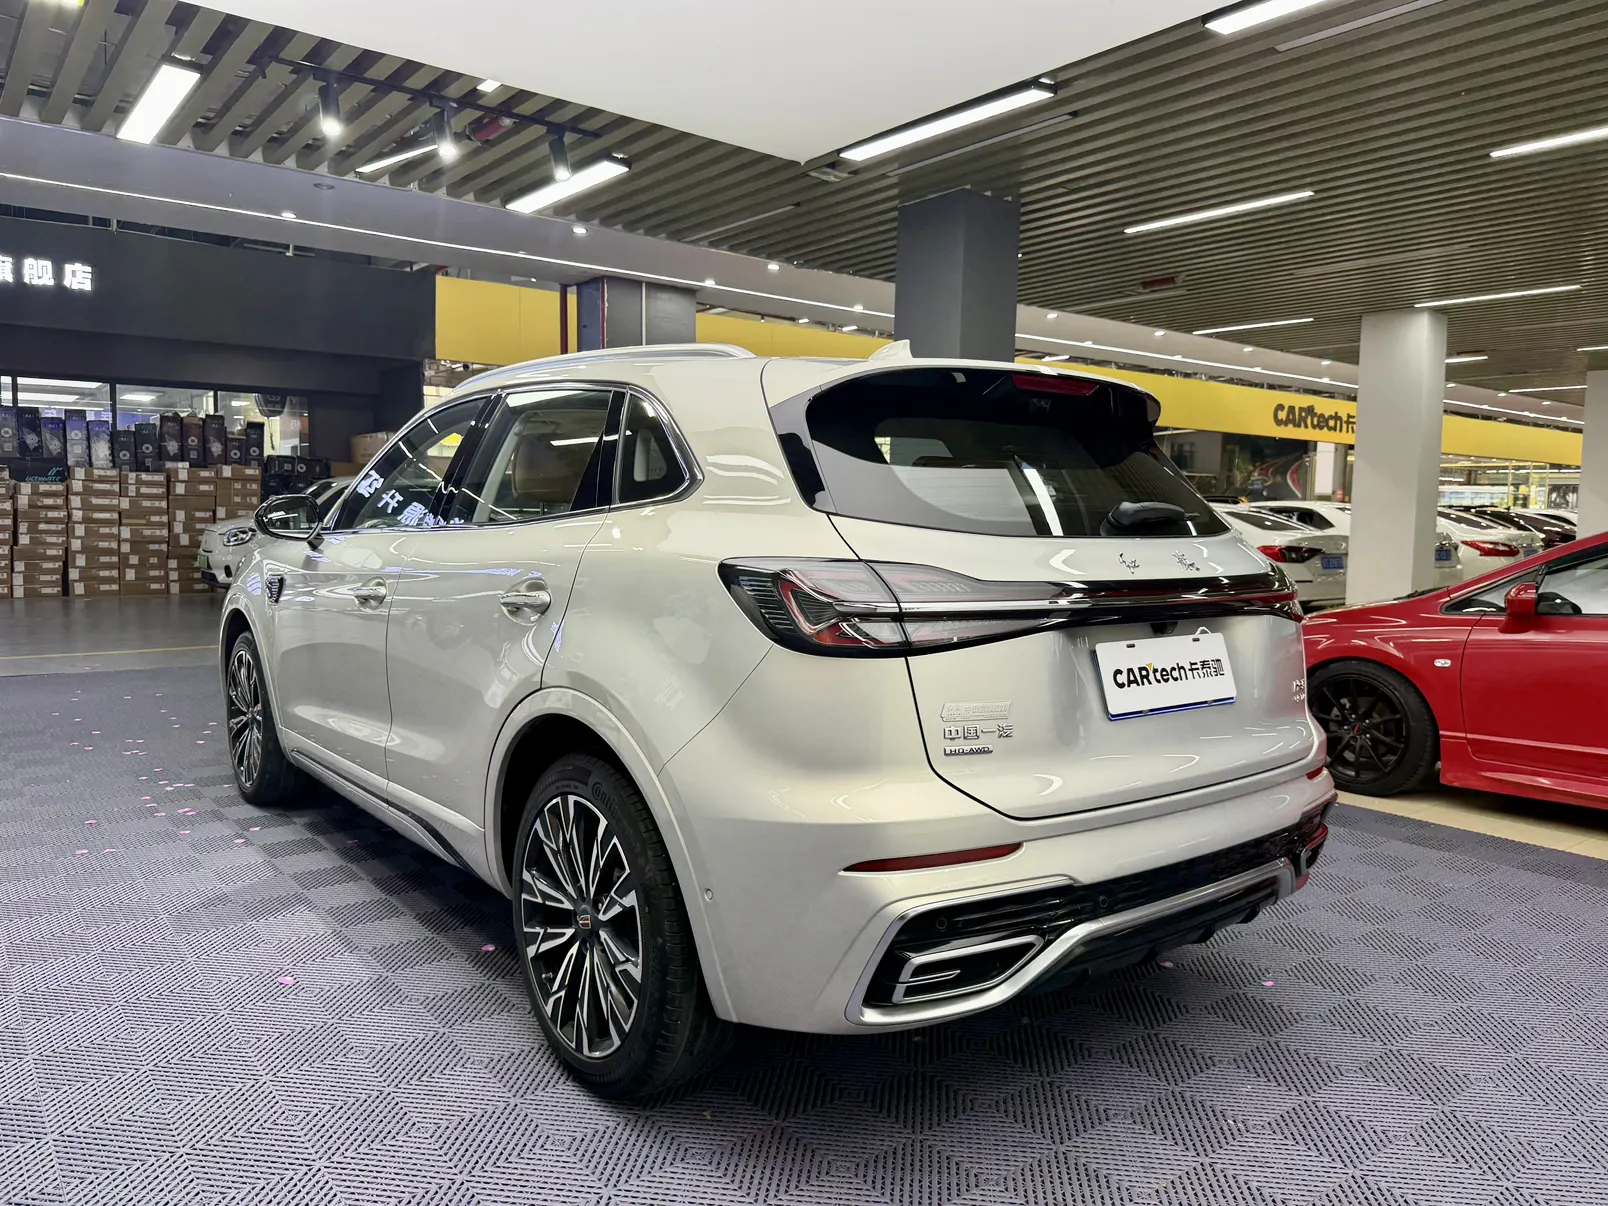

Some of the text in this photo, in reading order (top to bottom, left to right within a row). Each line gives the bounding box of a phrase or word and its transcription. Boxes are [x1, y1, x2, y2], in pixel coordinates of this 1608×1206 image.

[1273, 403, 1343, 433] CARtech
[1113, 658, 1225, 689] CARtech 卡泰驰
[943, 722, 1014, 741] 中国一汽
